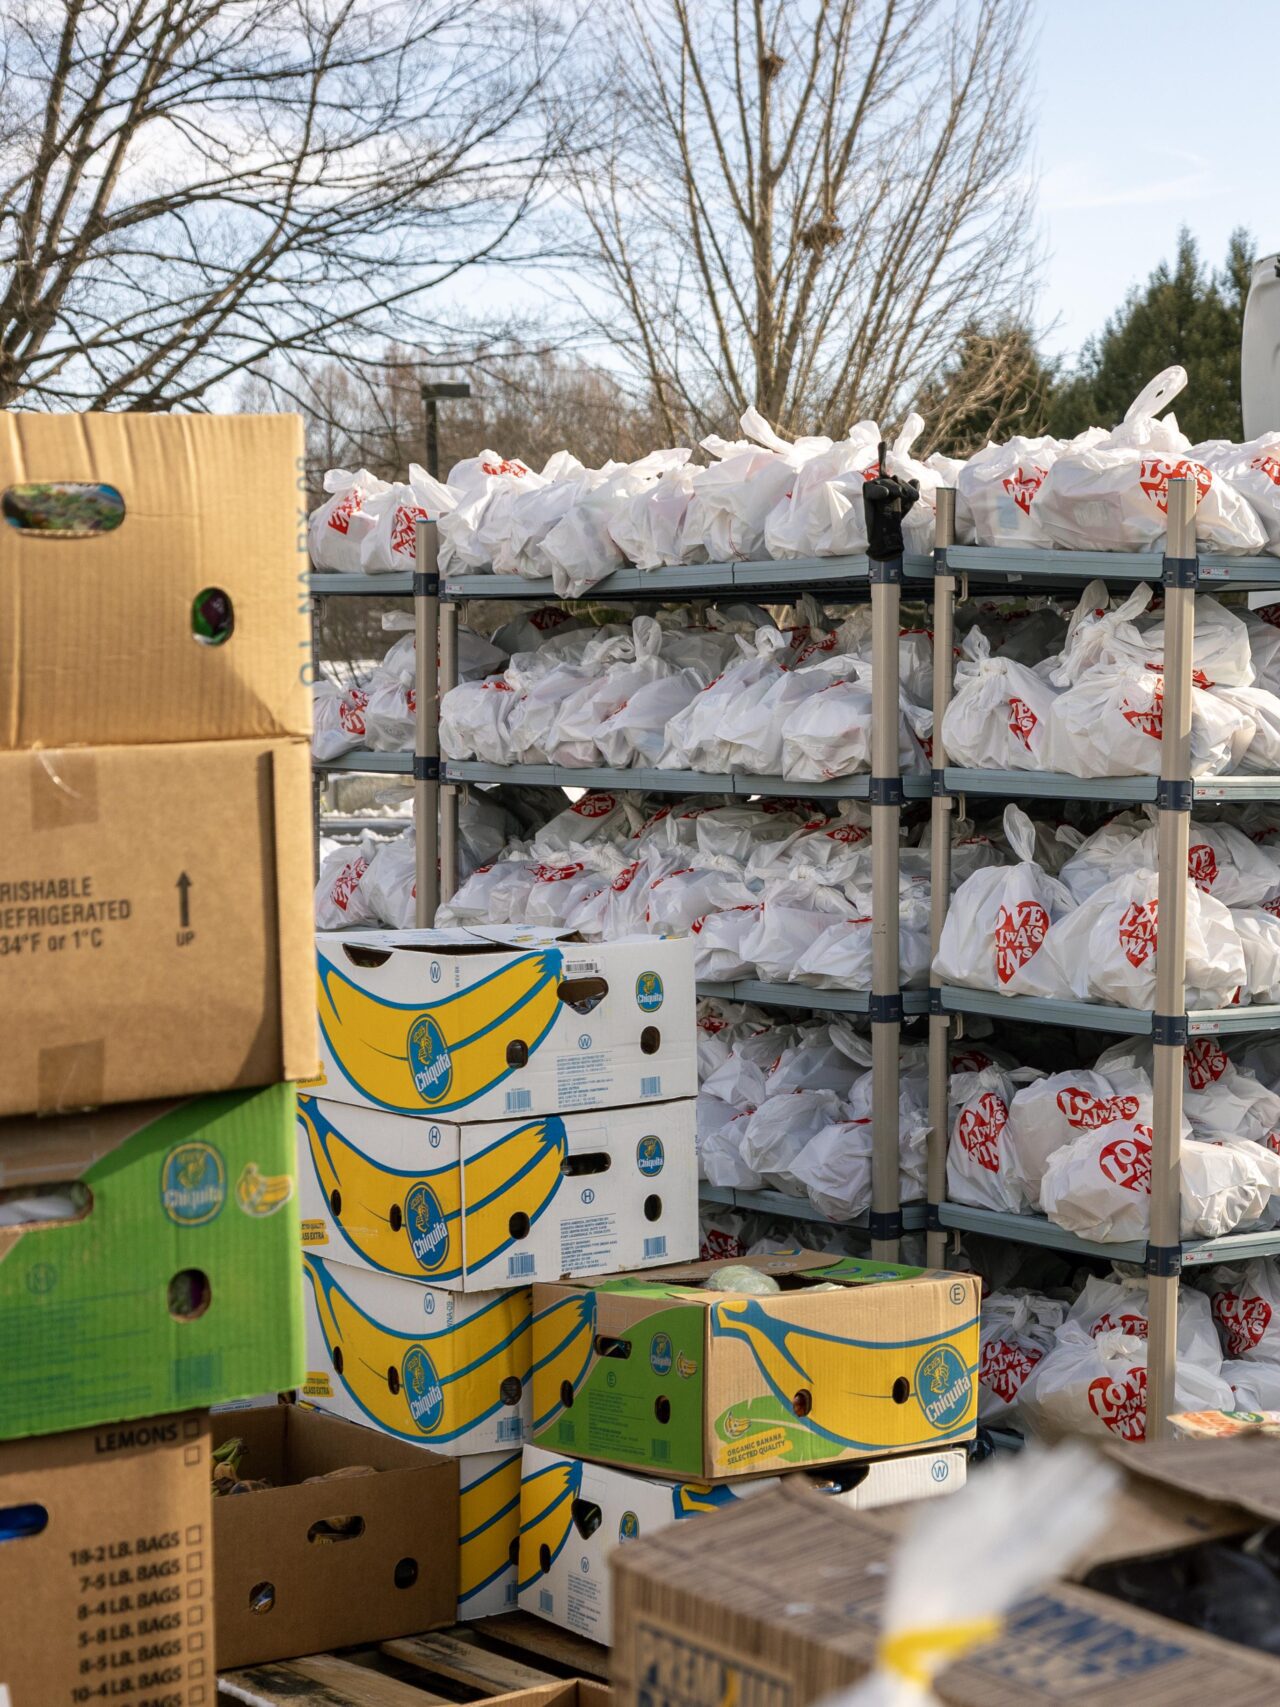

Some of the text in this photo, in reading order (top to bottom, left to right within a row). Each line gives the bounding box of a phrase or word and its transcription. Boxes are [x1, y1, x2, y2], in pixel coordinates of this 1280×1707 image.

[48, 935, 65, 951] or
[176, 930, 195, 947] UP
[637, 993, 663, 1005] Chiquita
[414, 1051, 452, 1093] Chiquita
[638, 1157, 664, 1169] Chiquita
[1101, 1126, 1152, 1184] LOV
[412, 1220, 449, 1260] Chiquita
[981, 1362, 1033, 1395] WINS
[410, 1384, 443, 1421] Chiquita
[925, 1374, 972, 1423] Chiquita
[1090, 1371, 1146, 1418] LOV
[95, 1423, 177, 1454] LEMONS
[727, 1433, 782, 1457] ORGANIC BANANA
[727, 1440, 785, 1465] SELECTED QUALITY
[136, 1531, 180, 1554] BAGS
[137, 1559, 181, 1581] BAGS
[137, 1585, 181, 1608] BAGS
[138, 1611, 181, 1635] BAGS
[138, 1639, 182, 1662] BAGS
[138, 1666, 182, 1689] BAGS
